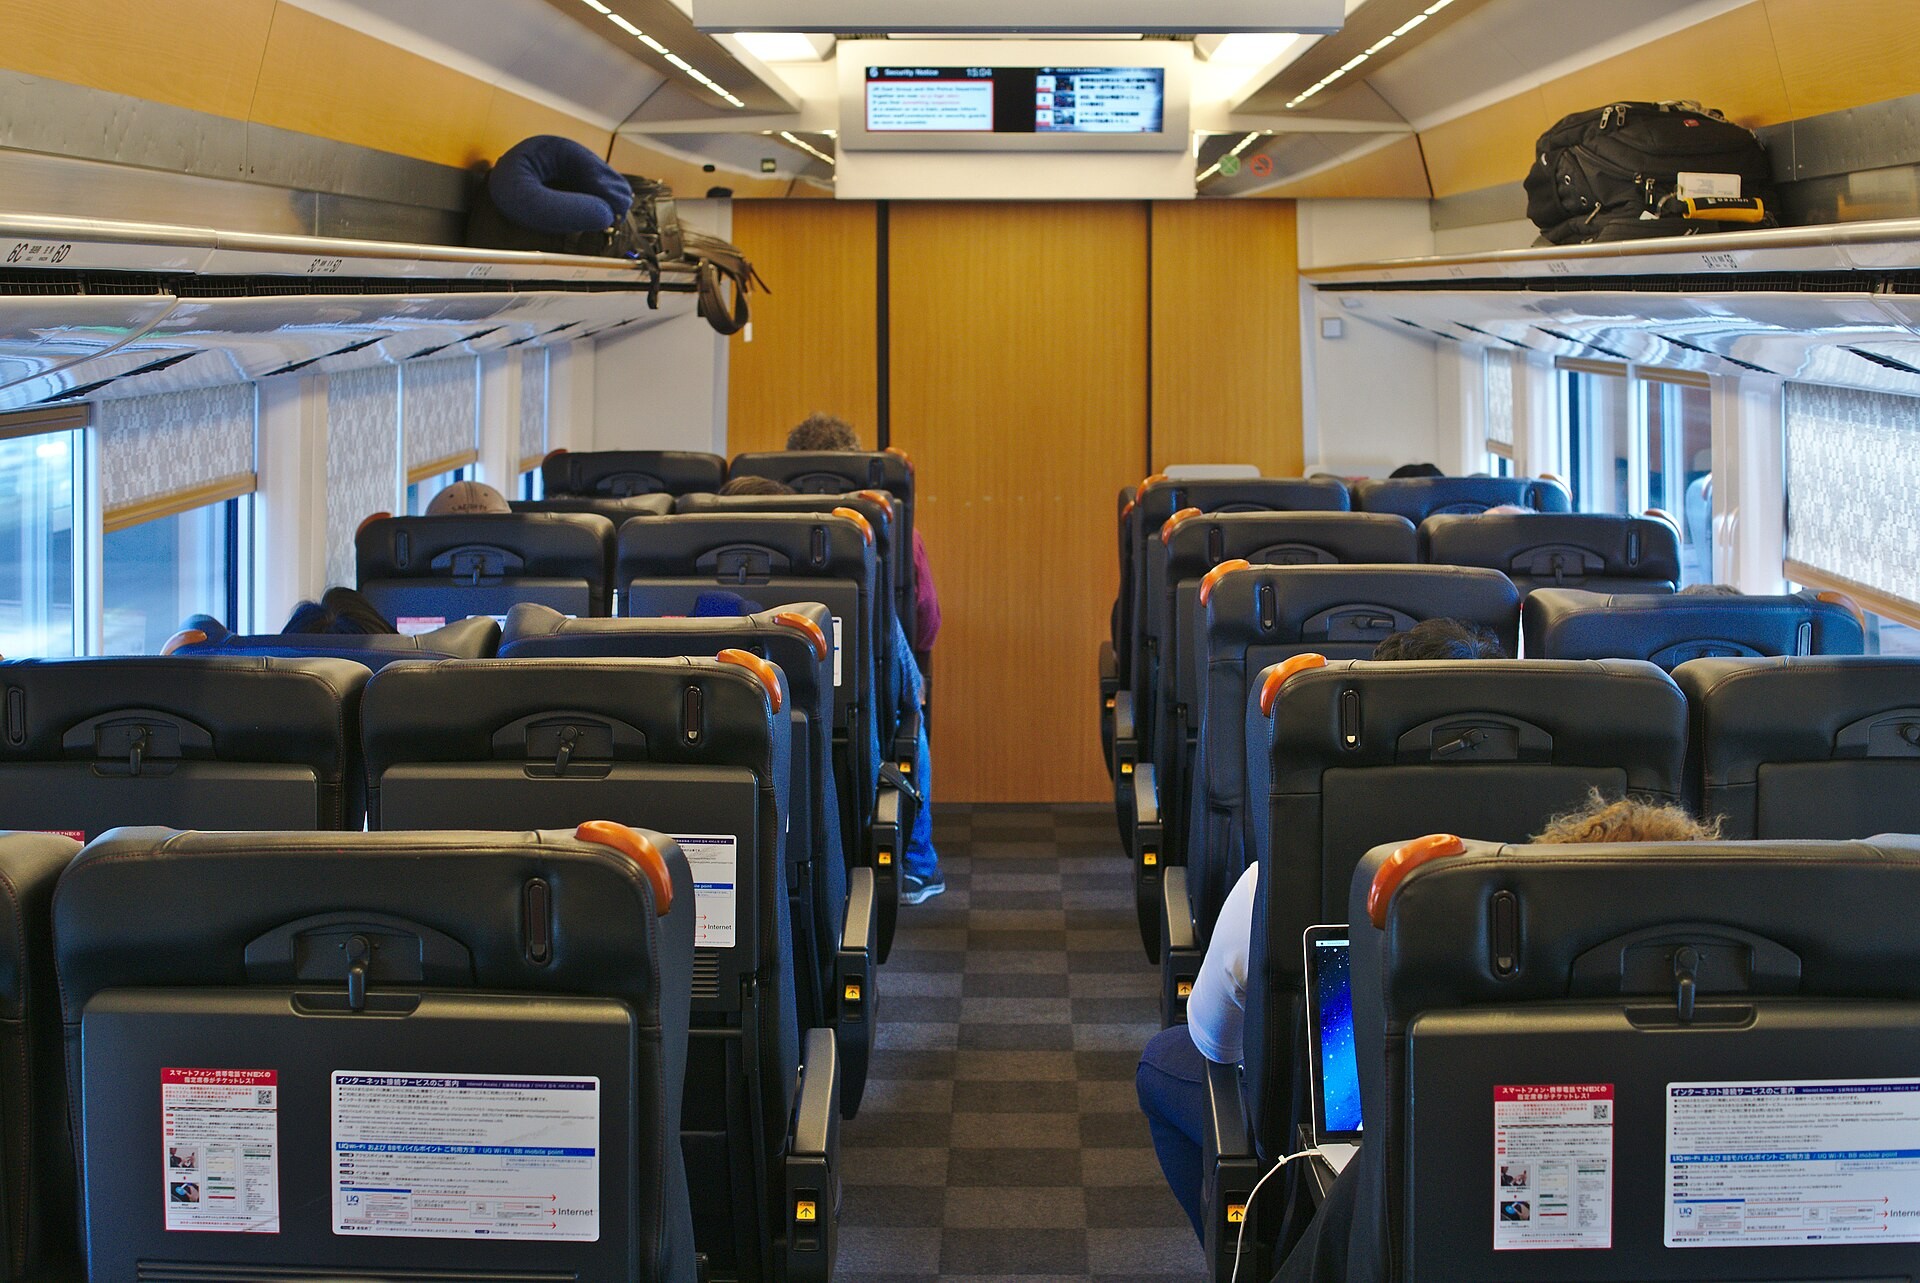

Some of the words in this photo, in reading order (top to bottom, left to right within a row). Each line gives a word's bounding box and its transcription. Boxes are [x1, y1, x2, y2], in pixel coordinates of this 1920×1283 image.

[884, 69, 914, 77] Security
[7, 243, 28, 263] 6C
[51, 244, 71, 263] 6D
[558, 1208, 593, 1216] Internet
